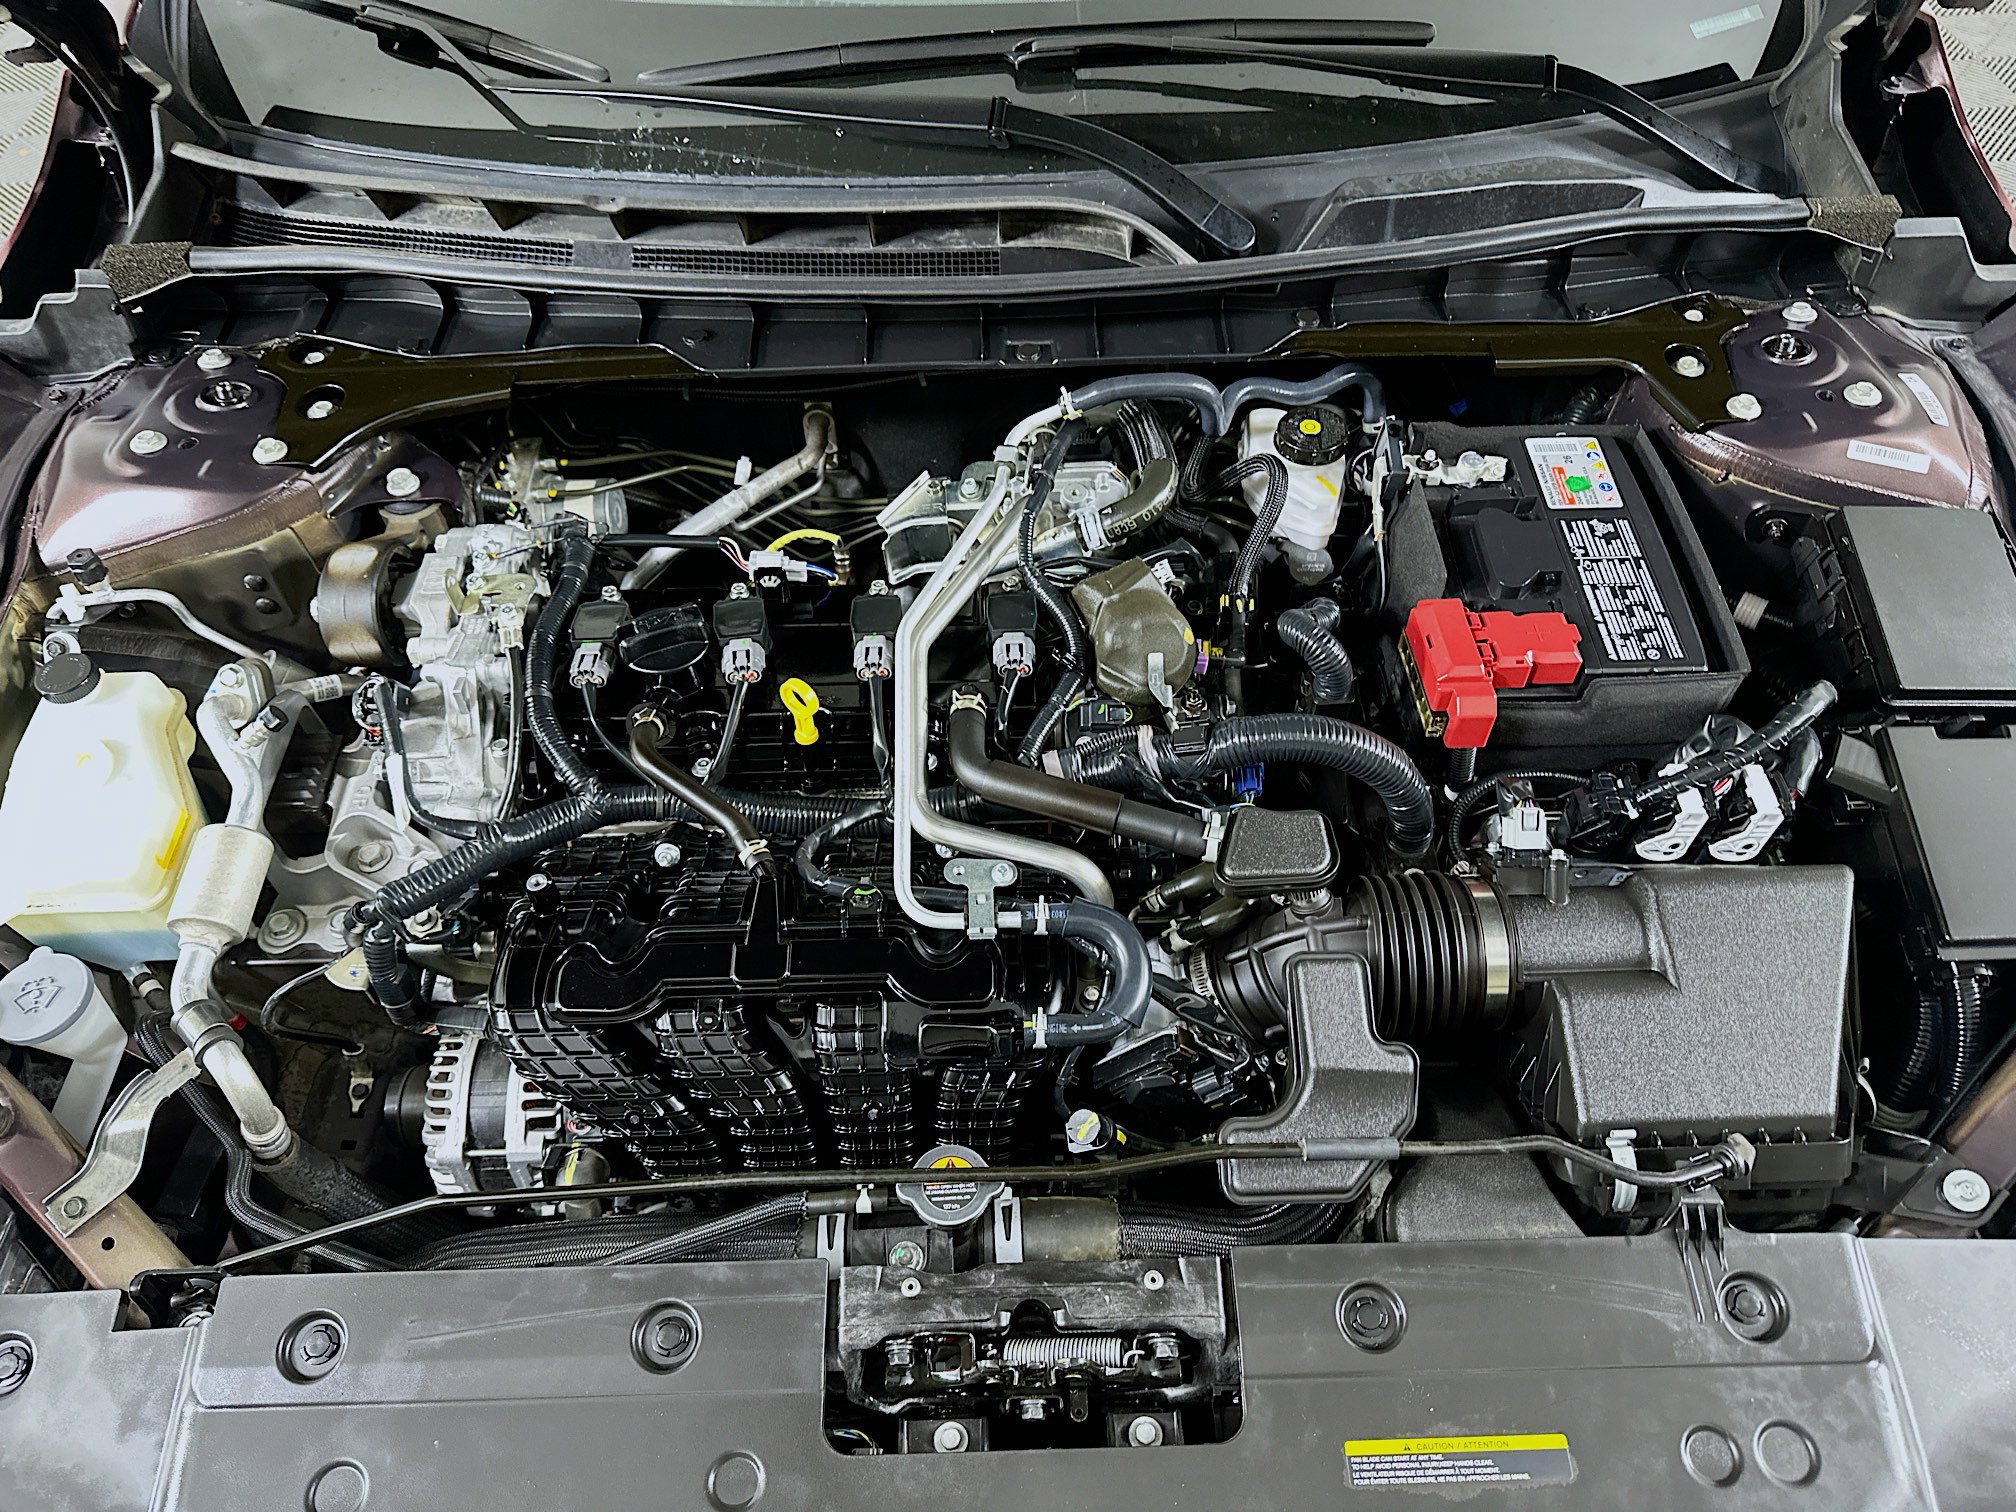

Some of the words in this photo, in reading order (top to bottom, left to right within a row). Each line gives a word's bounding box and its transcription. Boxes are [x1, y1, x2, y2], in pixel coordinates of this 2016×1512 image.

[1538, 464, 1548, 484] NISSAN
[1045, 1023, 1067, 1033] NGINE
[1417, 1442, 1454, 1451] CAUTION
[1463, 1441, 1509, 1449] ATTENTION
[1370, 1477, 1389, 1485] ÉVITER
